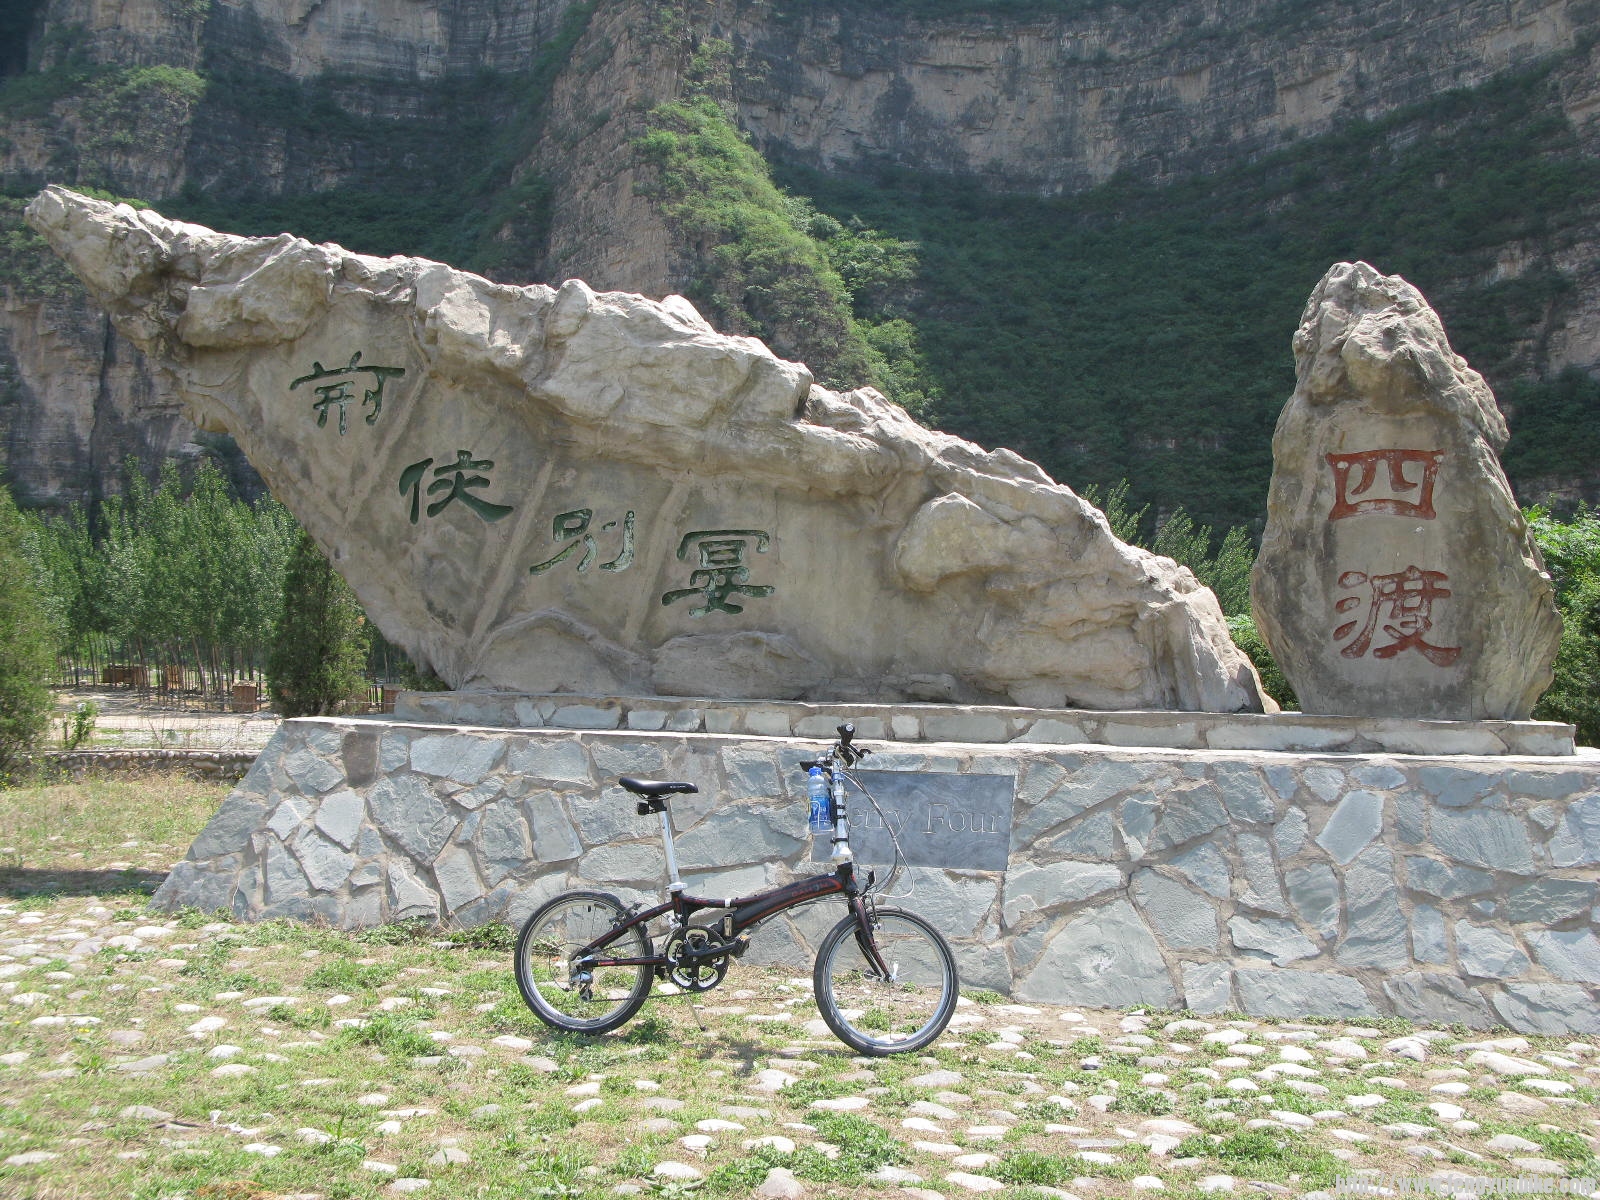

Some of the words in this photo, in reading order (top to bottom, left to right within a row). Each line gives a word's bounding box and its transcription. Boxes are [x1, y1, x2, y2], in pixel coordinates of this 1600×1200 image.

[1325, 449, 1462, 667] 四渡
[845, 804, 914, 836] erry
[922, 802, 1005, 834] Four
